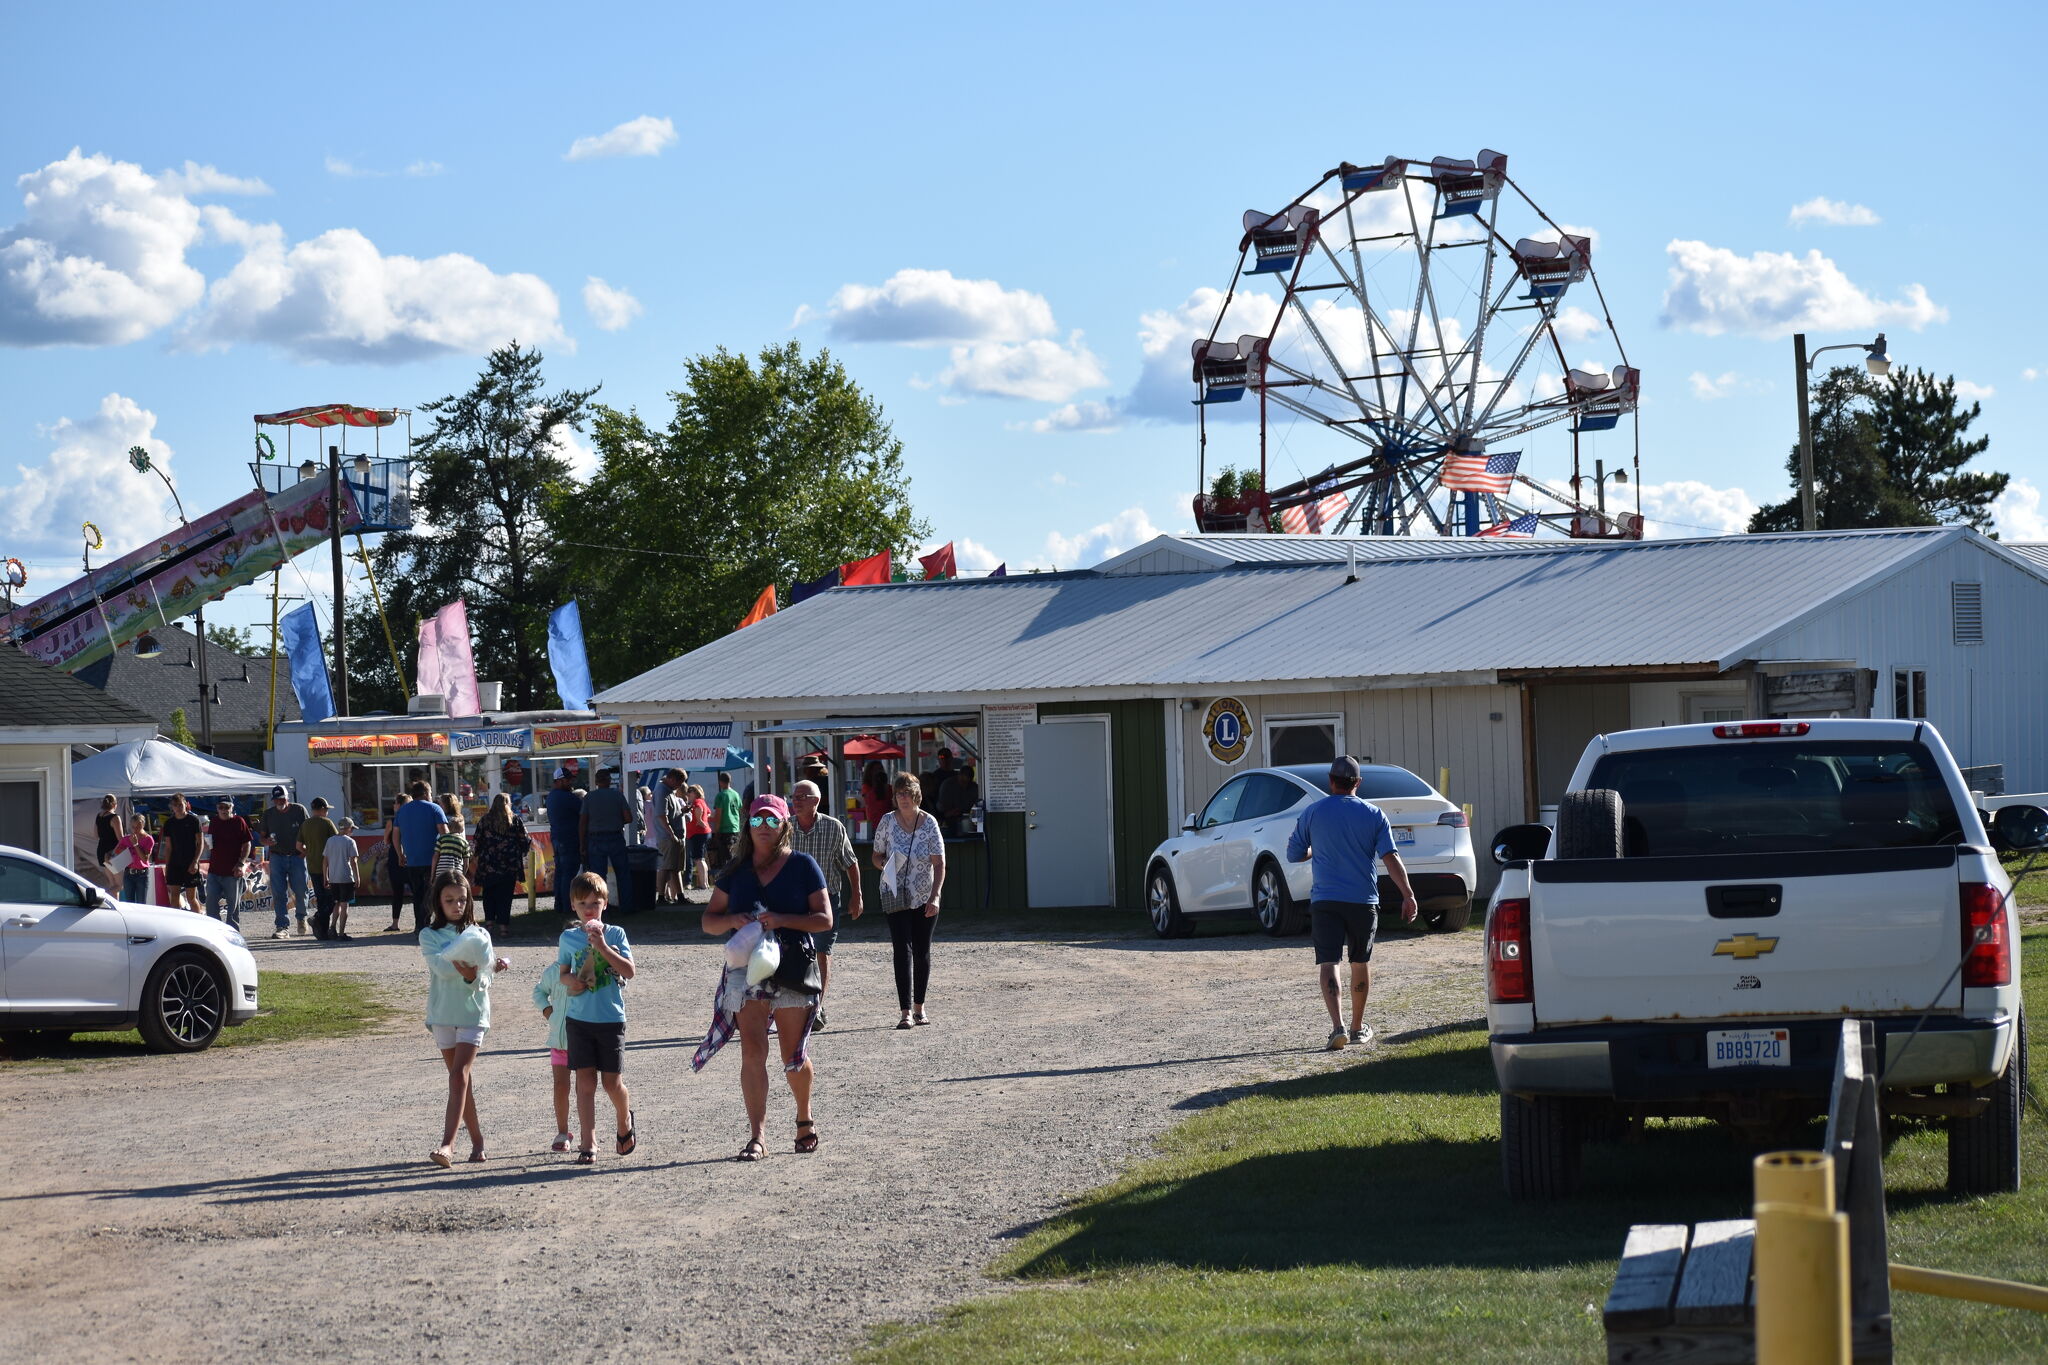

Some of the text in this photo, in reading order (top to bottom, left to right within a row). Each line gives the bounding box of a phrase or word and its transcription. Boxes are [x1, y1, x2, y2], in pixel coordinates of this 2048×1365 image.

[45, 612, 95, 654] Jill
[540, 727, 617, 749] FUNNEL CAKES
[645, 727, 665, 739] EVART
[686, 726, 705, 737] FOOD
[705, 725, 730, 737] BOOTH
[1222, 719, 1235, 741] L
[313, 738, 346, 758] FUNNEL
[383, 737, 416, 755] FUNNEL
[456, 732, 524, 752] COLD DRINKS
[630, 750, 656, 764] WELCOME
[687, 748, 710, 760] COUNTY
[711, 748, 725, 760] FAIR
[1716, 1040, 1780, 1060] BB89720
